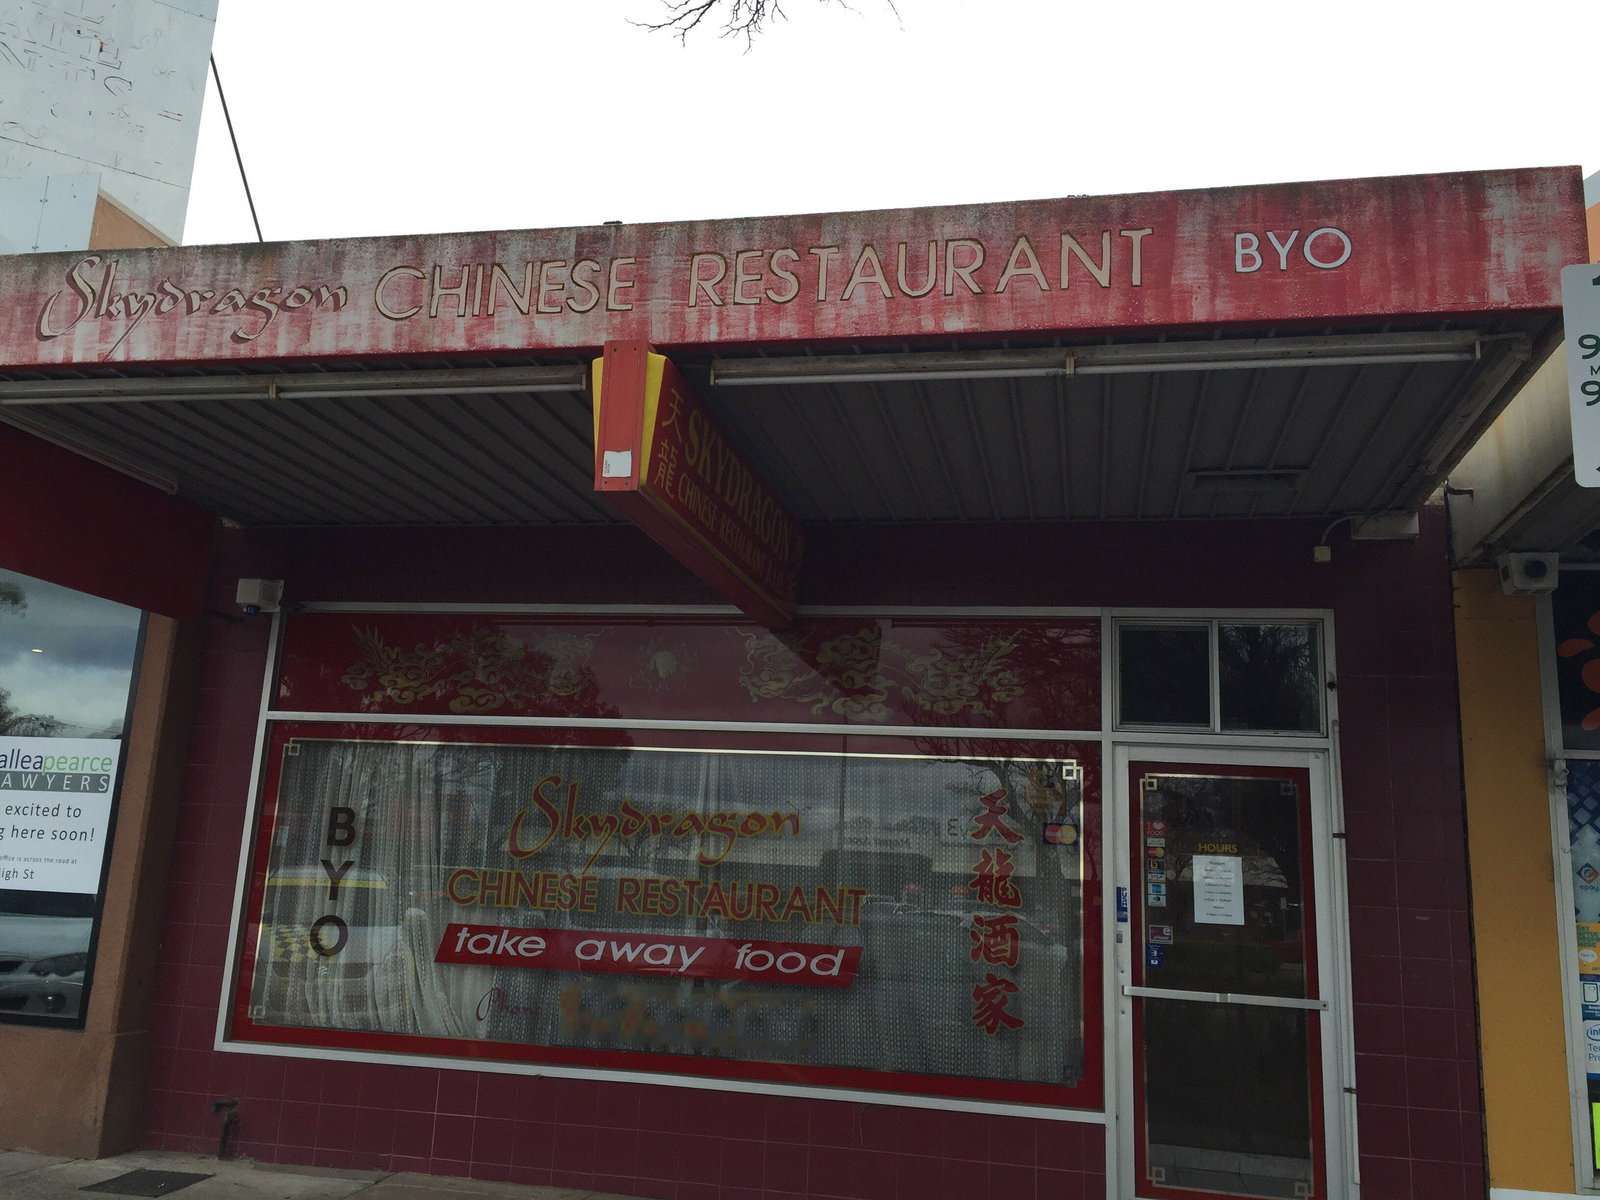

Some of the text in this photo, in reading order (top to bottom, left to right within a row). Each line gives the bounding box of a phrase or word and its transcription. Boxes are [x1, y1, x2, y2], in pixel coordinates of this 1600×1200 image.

[37, 226, 1353, 361] Skydragon CHINESE RESTAURANT BYO
[678, 472, 717, 531] CHINESE
[685, 408, 794, 563] SKYDRAGON
[5, 803, 82, 818] excited to
[11, 825, 45, 840] here
[51, 828, 95, 842] soon!
[508, 774, 800, 874] Skydragon
[0, 868, 34, 881] igh St
[1198, 843, 1238, 853] HOURS
[309, 806, 357, 957] BYO
[447, 868, 867, 927] CHINESE RESTAURANT
[968, 787, 1025, 1036] 天龍酒家
[454, 927, 845, 976] take away food
